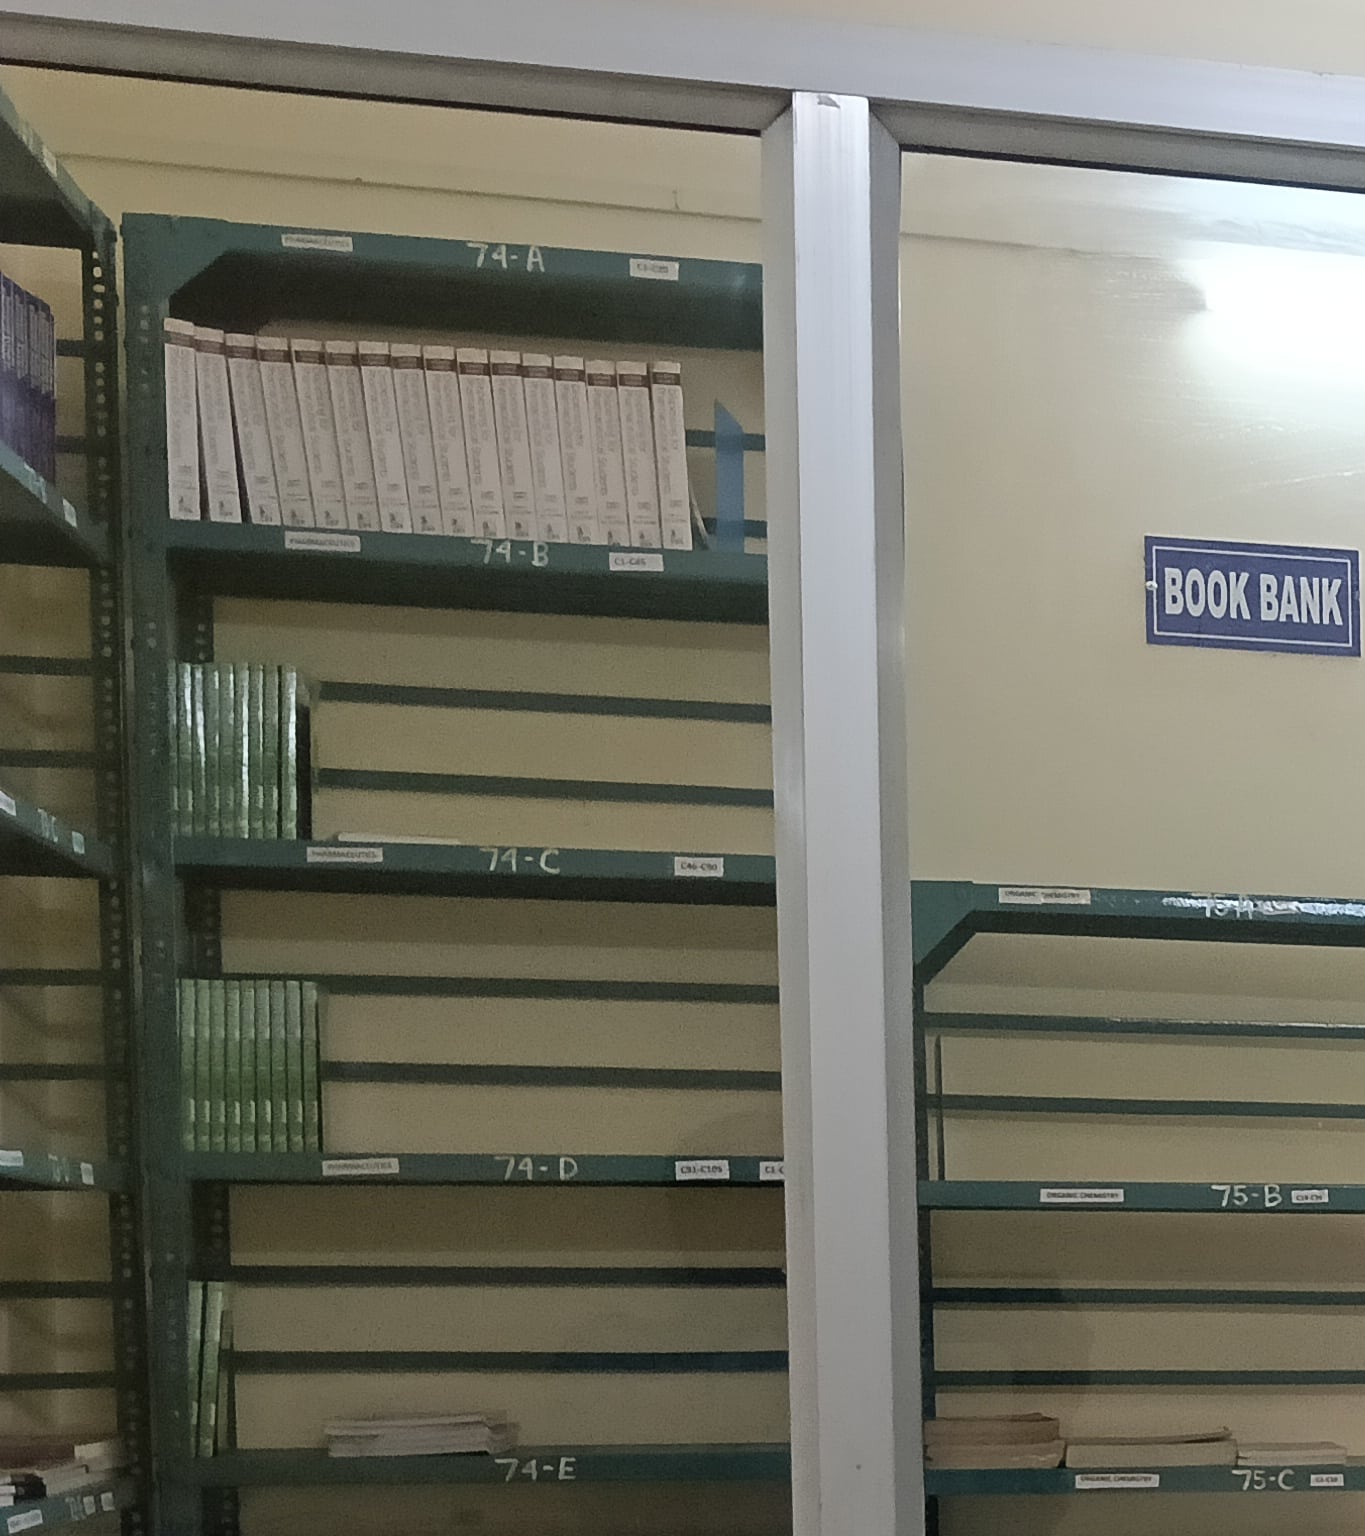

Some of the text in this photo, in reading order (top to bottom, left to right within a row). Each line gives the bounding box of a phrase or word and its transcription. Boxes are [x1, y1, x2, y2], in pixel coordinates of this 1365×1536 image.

[467, 242, 546, 272] 74-A
[472, 538, 550, 568] 74-B
[1163, 567, 1343, 626] BOOK BANK
[478, 847, 562, 876] 74-C
[493, 1156, 579, 1182] 74-D
[1080, 1191, 1119, 1199] CHEMISTRY
[1211, 1185, 1283, 1208] 75-B
[495, 1456, 577, 1482] 74-E
[1231, 1468, 1295, 1492] 75-C
